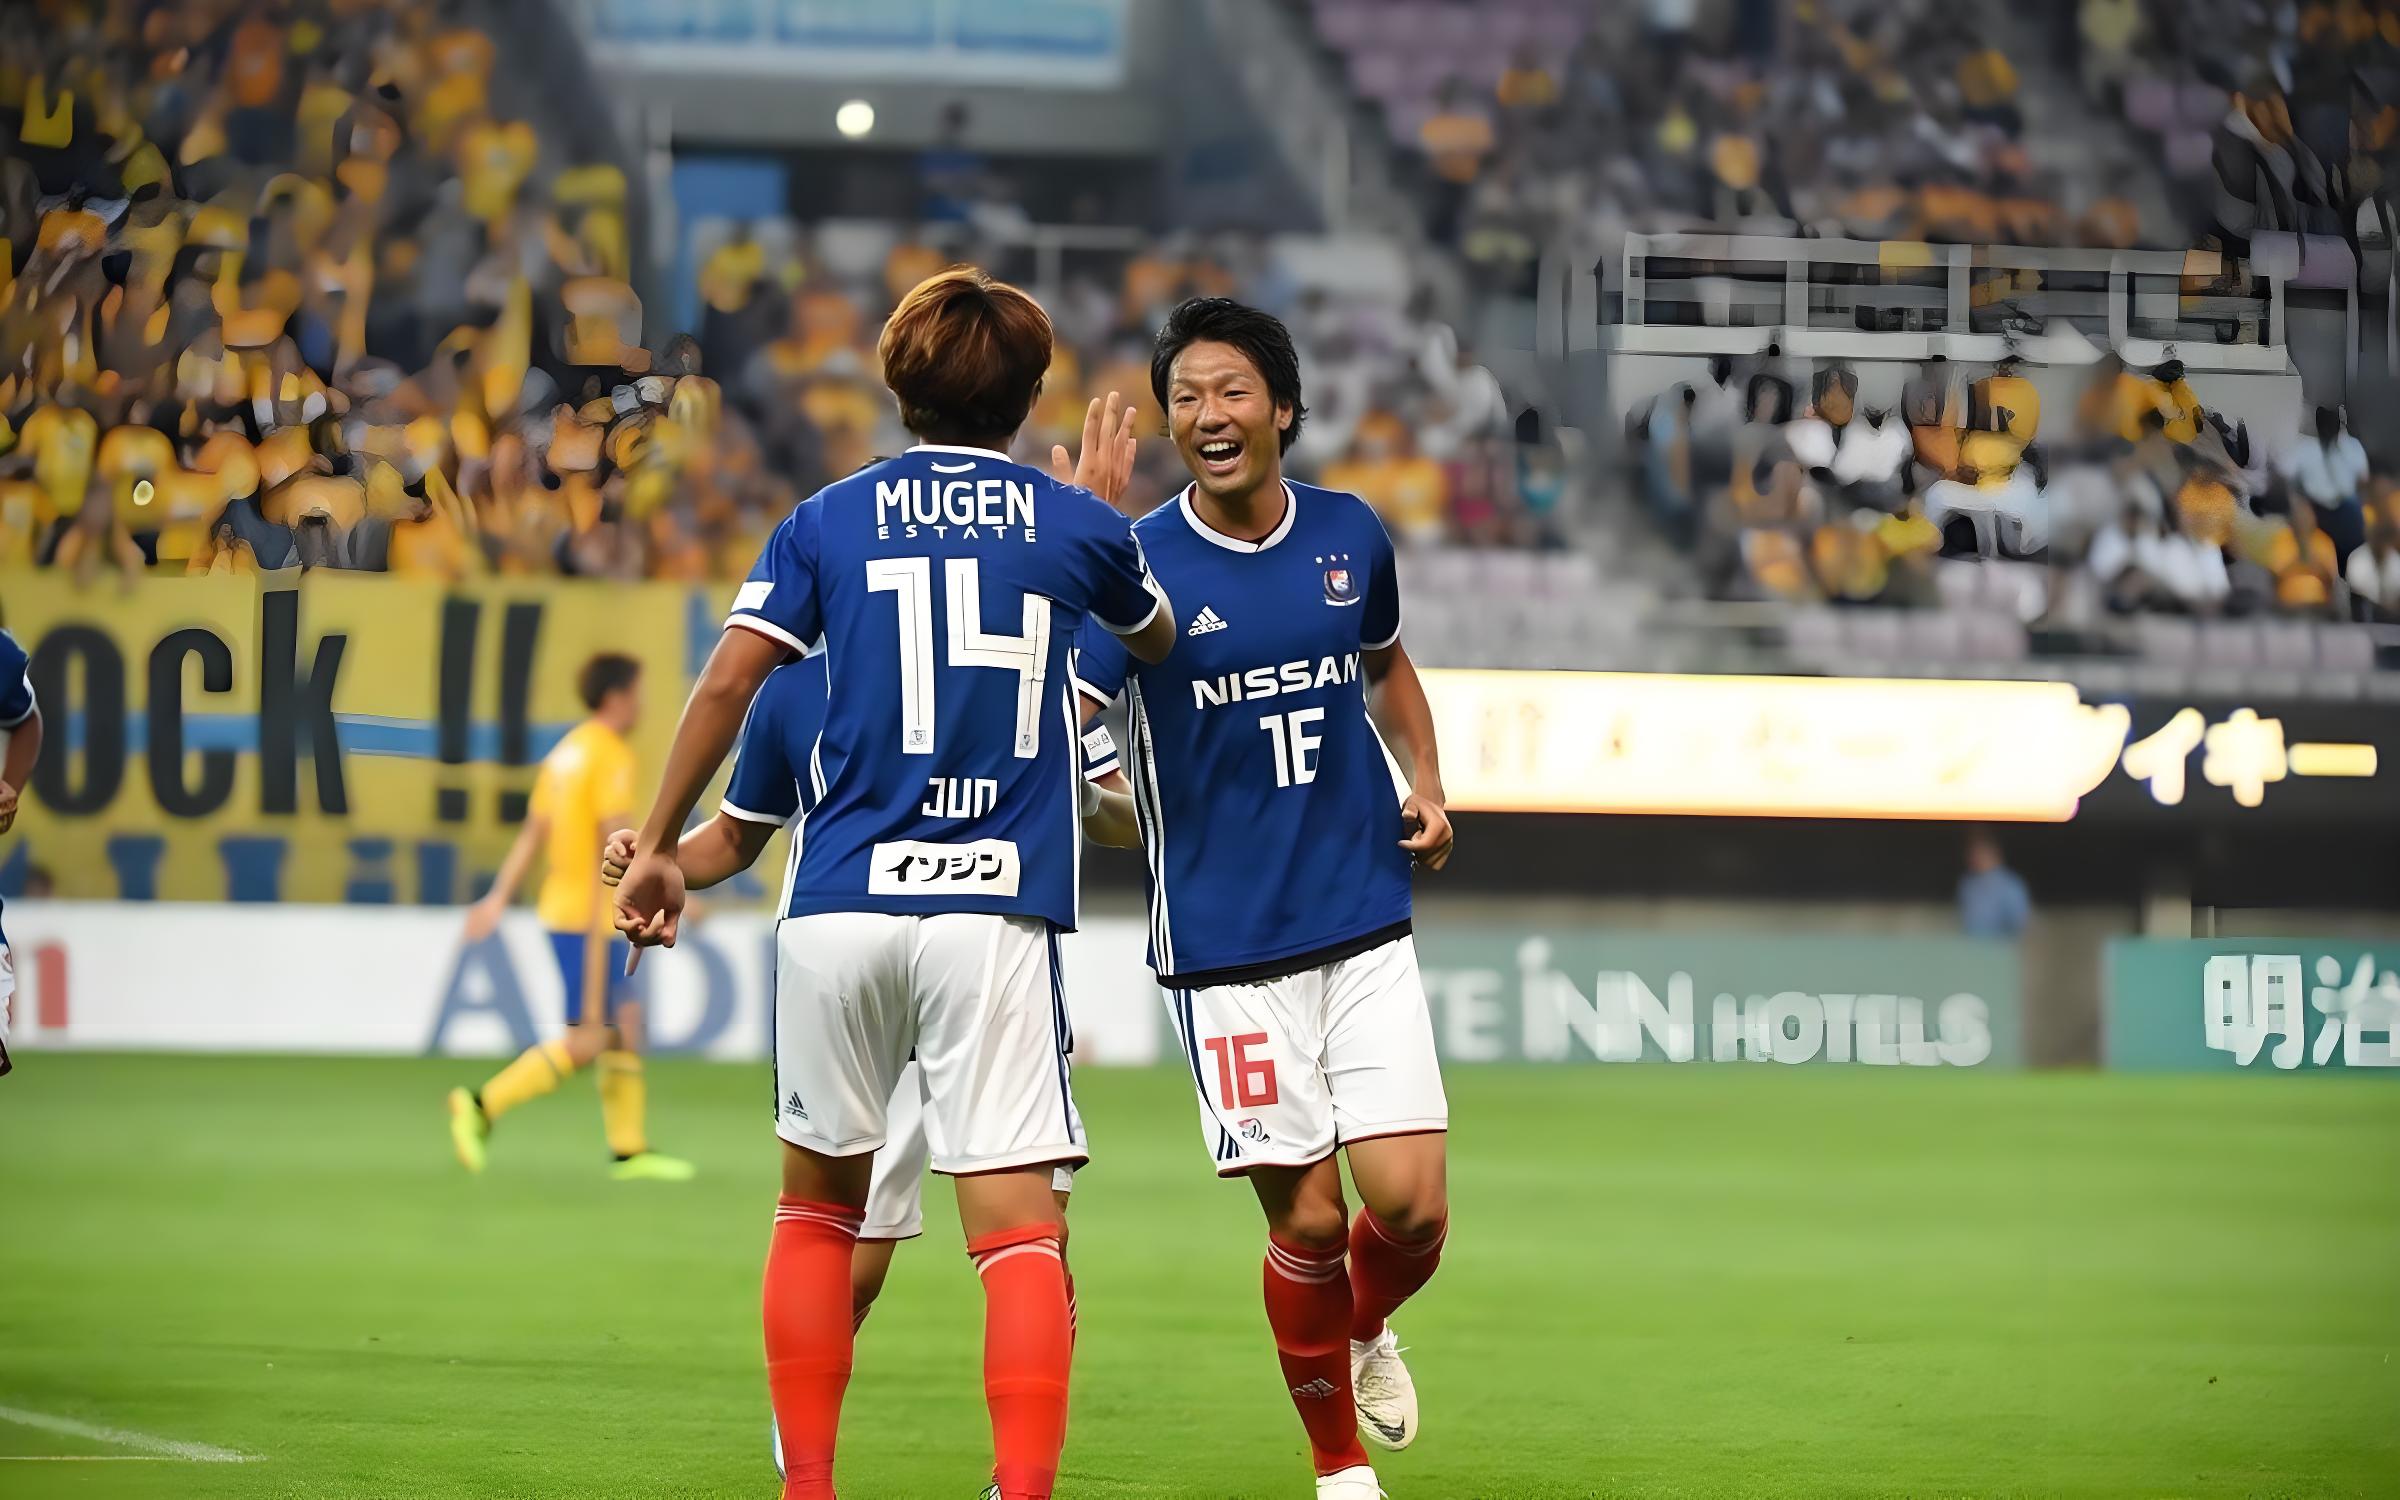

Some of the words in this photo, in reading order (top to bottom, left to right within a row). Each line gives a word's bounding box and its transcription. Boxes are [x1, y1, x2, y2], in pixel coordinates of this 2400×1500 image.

[876, 478, 1035, 527] MUGEN
[877, 524, 1037, 543] ESTATE
[866, 556, 1052, 759] 14
[1191, 651, 1360, 710] NISSAN
[1259, 706, 1325, 788] 16
[921, 777, 998, 818] JUN
[885, 852, 1003, 882] イソジン
[1204, 1031, 1279, 1110] 16
